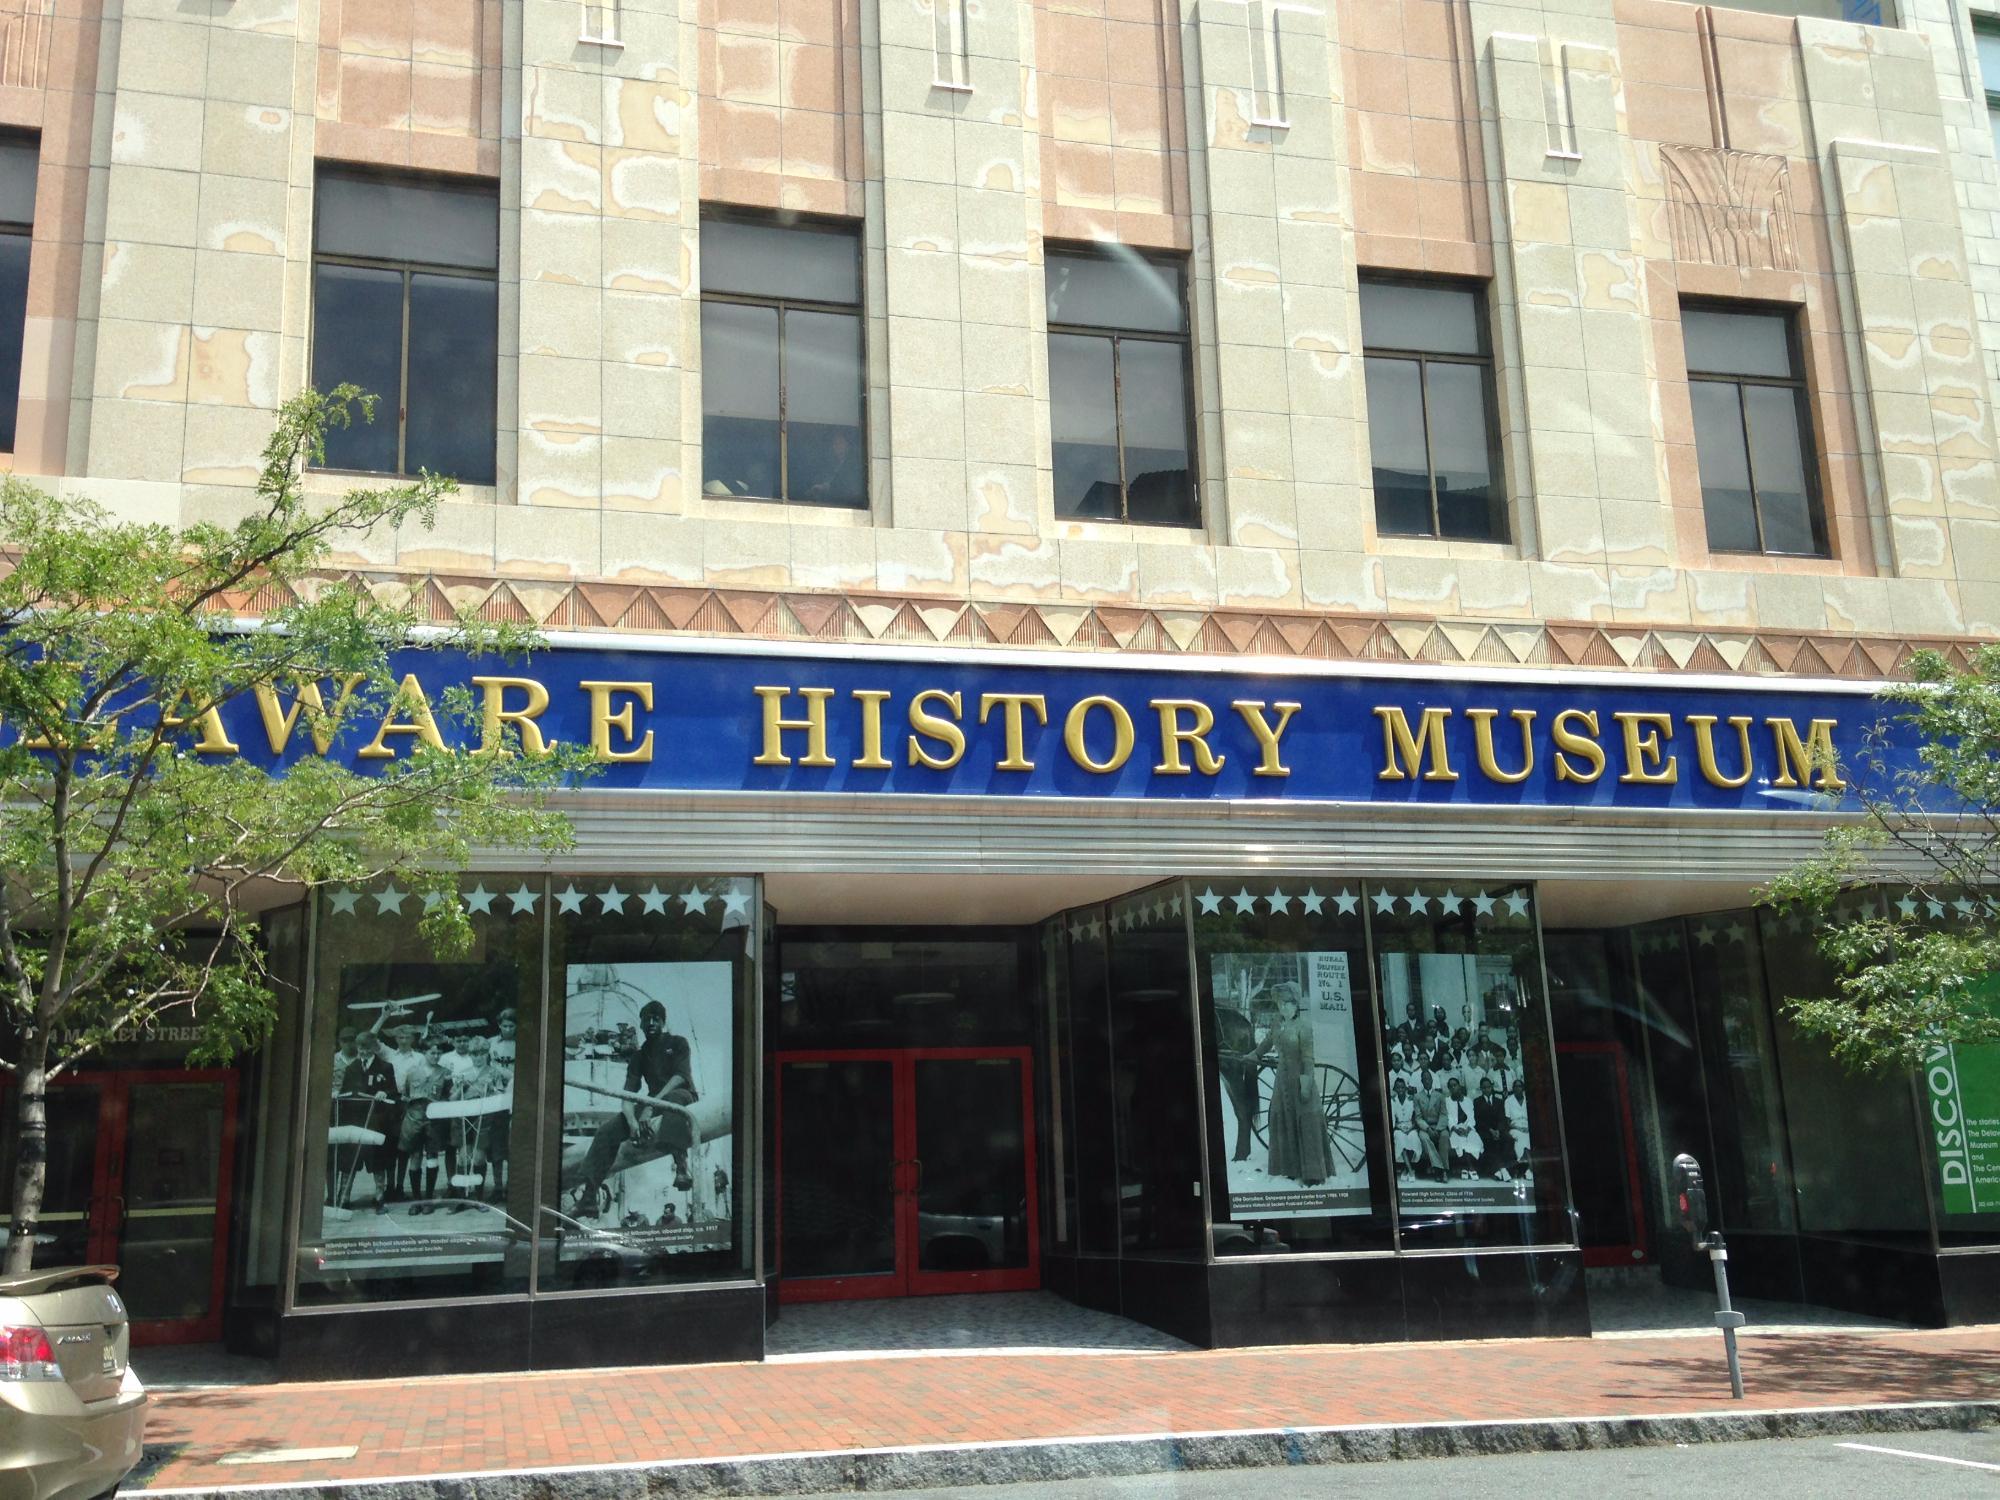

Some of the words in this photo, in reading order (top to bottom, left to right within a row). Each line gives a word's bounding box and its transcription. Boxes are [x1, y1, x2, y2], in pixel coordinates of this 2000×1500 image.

[753, 686, 1301, 776] HISTORY
[1374, 706, 1846, 788] MUSEUM
[1317, 971, 1346, 979] ROUTE
[1970, 1141, 1998, 1149] Museum
[1975, 1176, 2000, 1184] Americ
